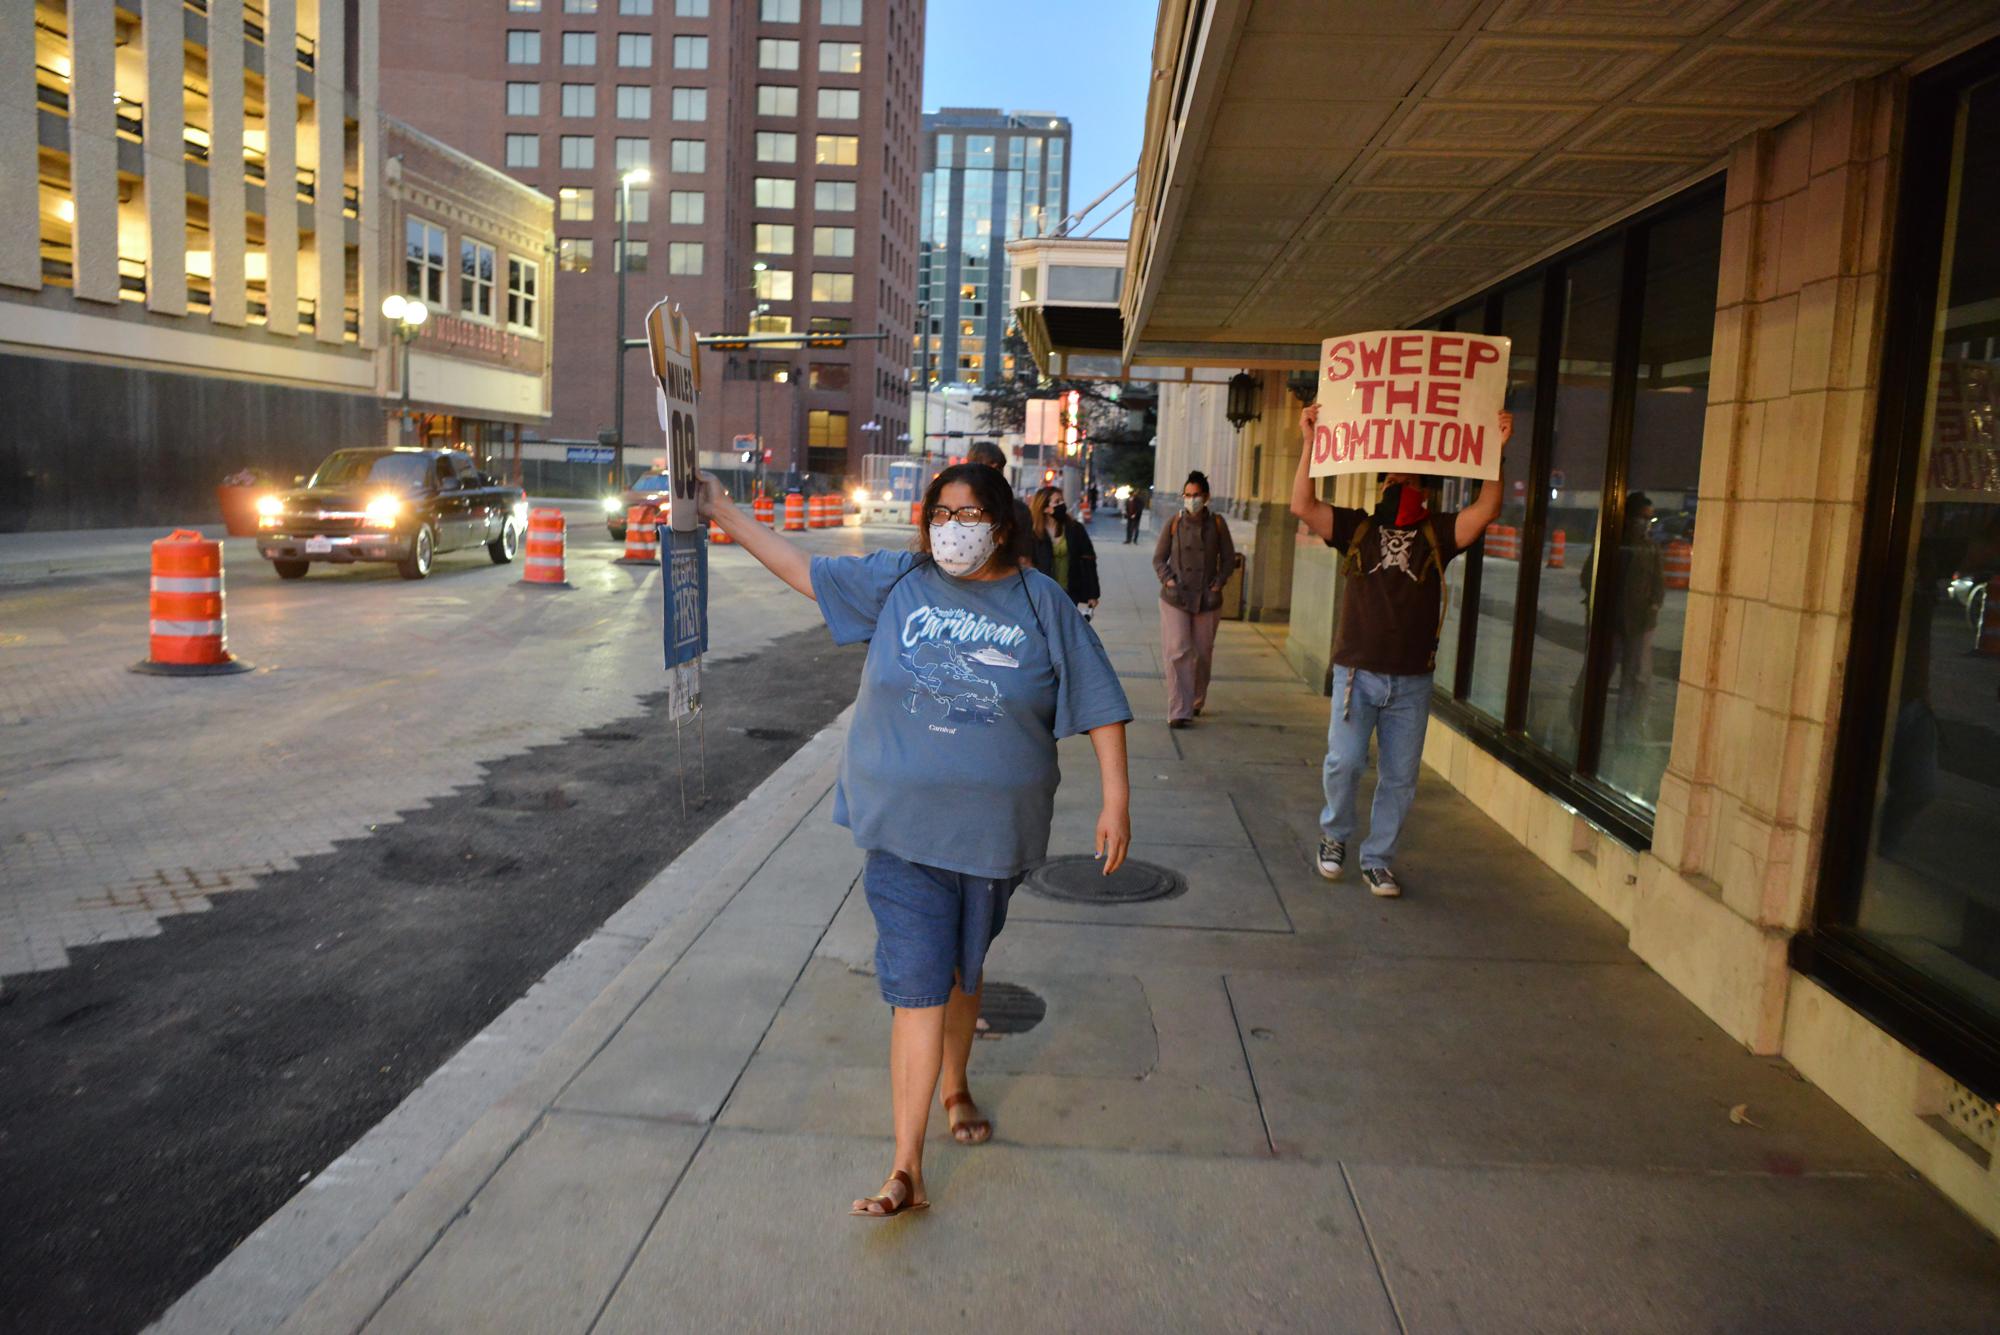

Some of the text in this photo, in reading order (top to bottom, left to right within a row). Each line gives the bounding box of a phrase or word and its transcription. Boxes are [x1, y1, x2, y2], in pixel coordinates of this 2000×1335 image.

[1328, 336, 1499, 381] SWEEP
[667, 360, 694, 404] MULES
[1355, 380, 1462, 417] THE
[671, 409, 696, 500] 09
[1314, 419, 1485, 466] DOMINION
[671, 557, 699, 592] PEOPLE
[673, 587, 701, 640] FIRST
[902, 605, 1027, 648] Caribbean
[928, 723, 958, 735] Carnival
